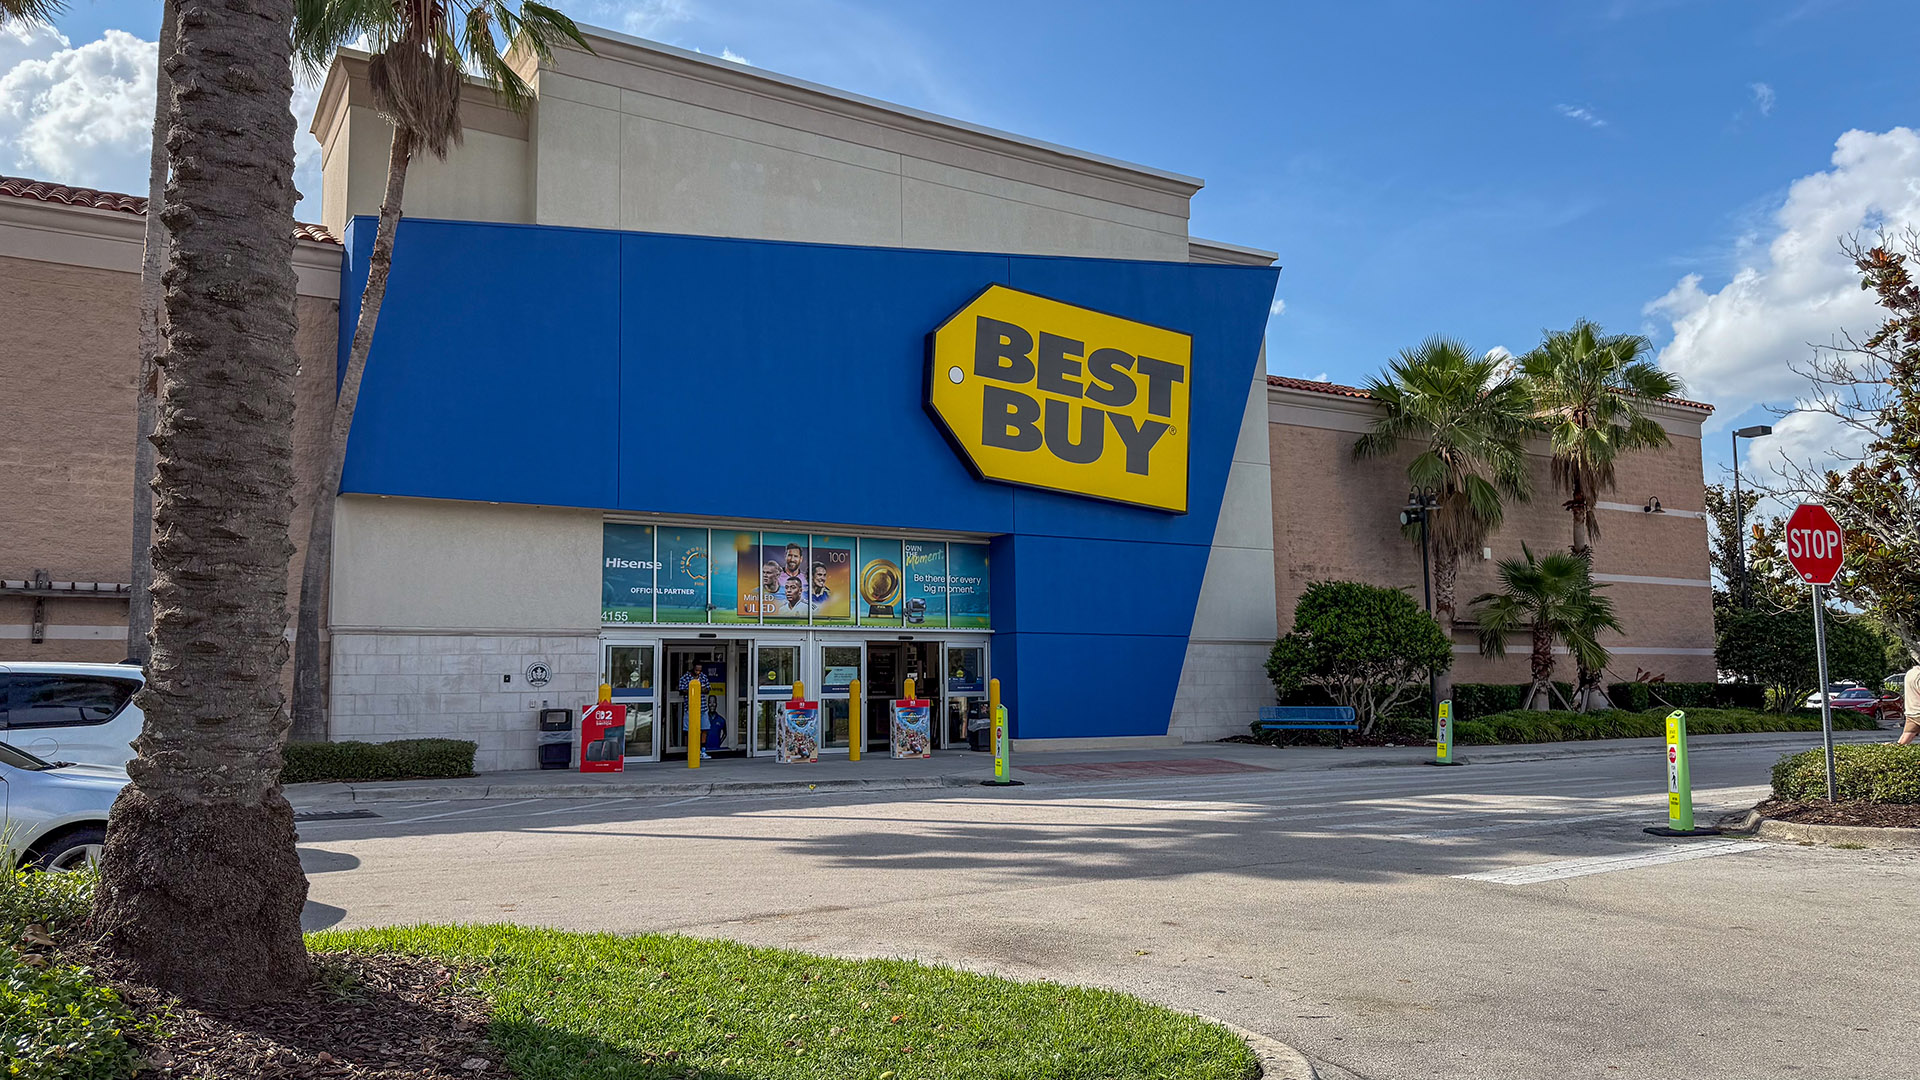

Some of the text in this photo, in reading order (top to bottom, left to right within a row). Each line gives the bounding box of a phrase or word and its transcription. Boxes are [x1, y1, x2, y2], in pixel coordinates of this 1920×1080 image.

[974, 315, 1185, 418] BEST
[981, 384, 1171, 476] BUY
[1790, 528, 1839, 559] STOP
[905, 551, 918, 559] THE
[605, 558, 662, 570] Hisense
[913, 573, 981, 586] Be there for every
[630, 587, 695, 596] OFFICIAL PARTNER
[923, 584, 975, 595] big moment.
[744, 603, 776, 613] ULED
[601, 611, 628, 621] 4155
